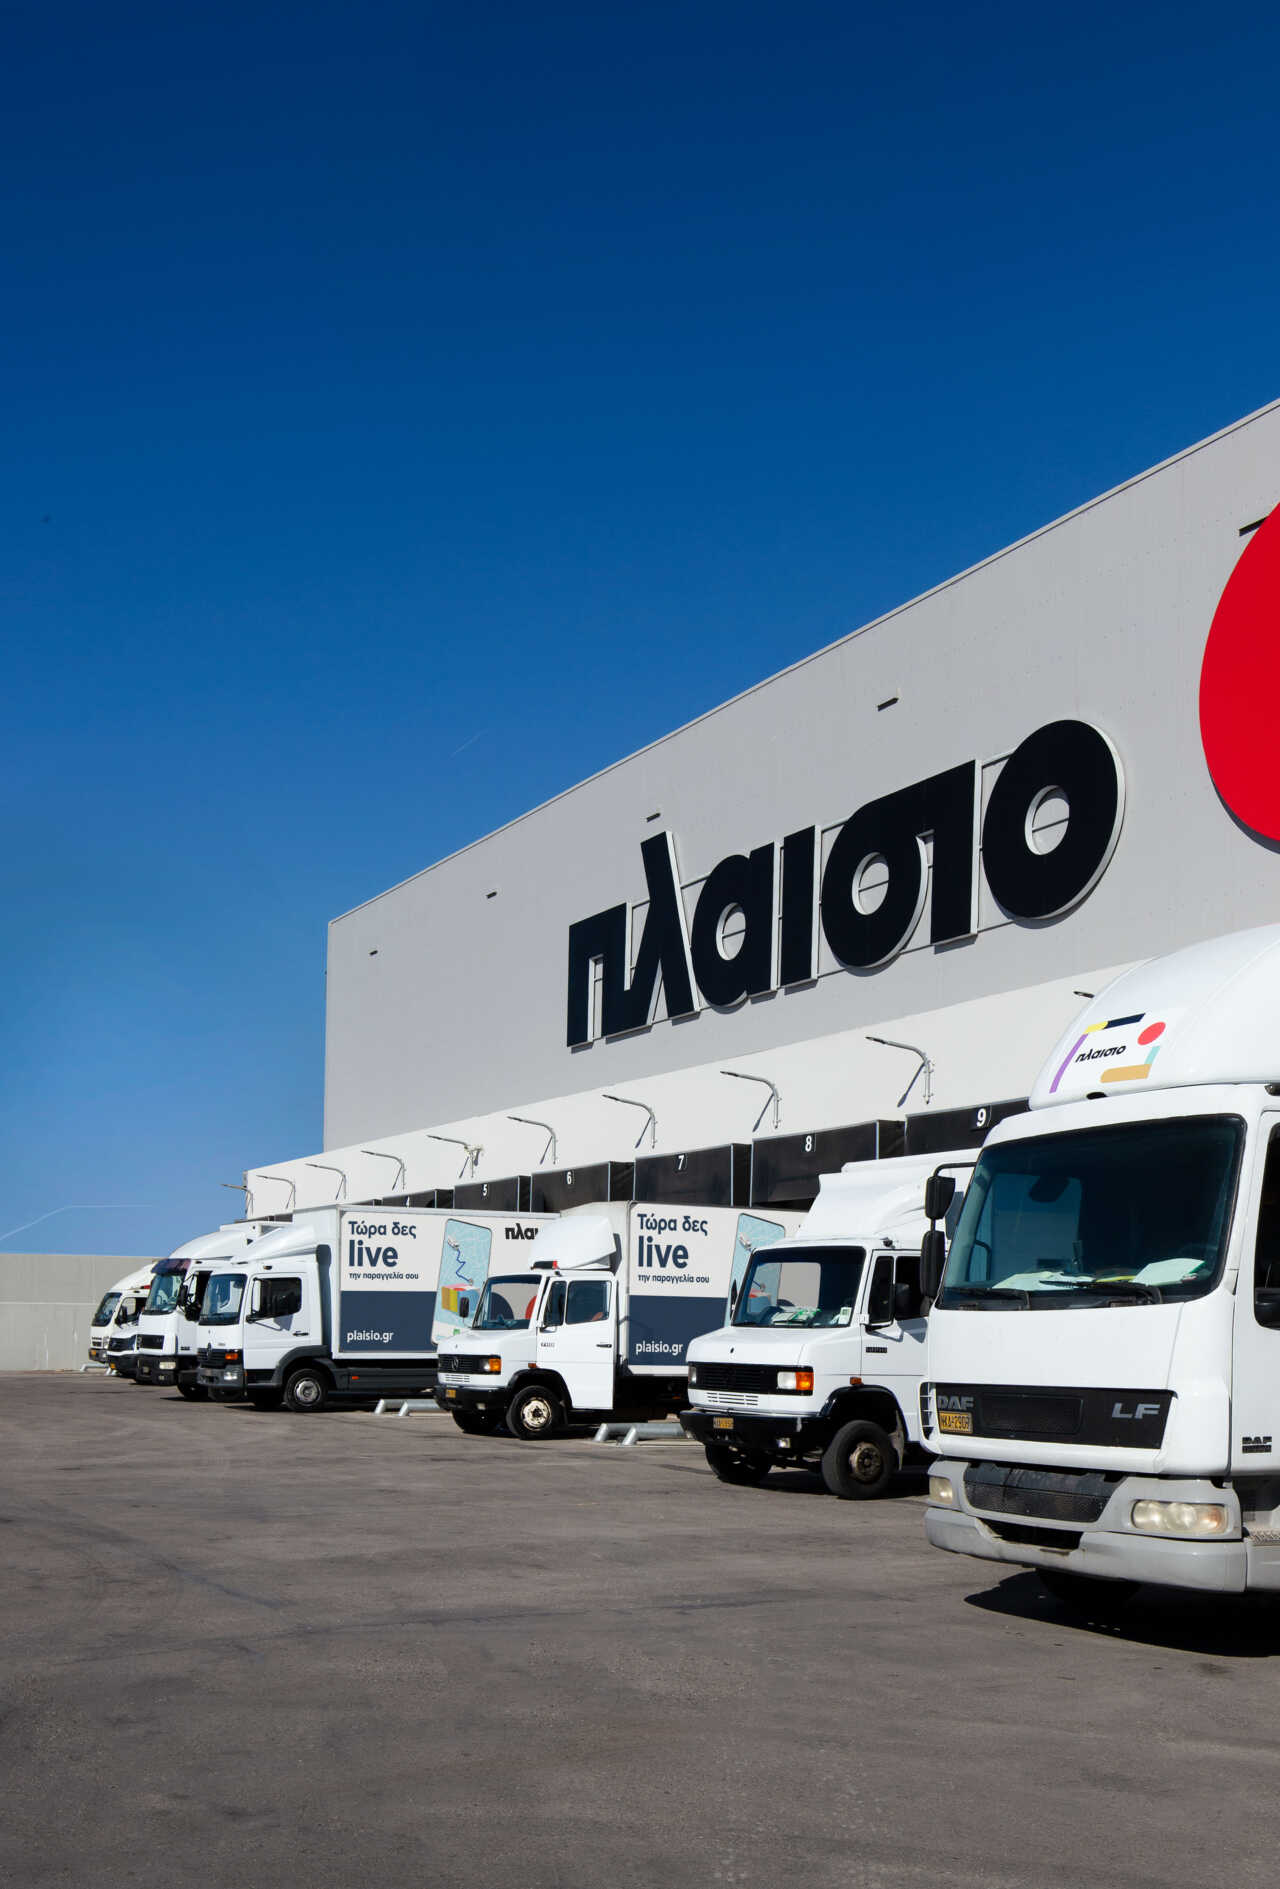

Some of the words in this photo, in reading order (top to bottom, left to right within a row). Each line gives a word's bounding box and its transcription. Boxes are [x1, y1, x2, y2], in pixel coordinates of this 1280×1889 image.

[976, 1108, 987, 1127] 9
[805, 1135, 813, 1153] 8
[677, 1154, 685, 1170] 7
[567, 1171, 573, 1185] 6
[482, 1184, 488, 1197] 5
[348, 1220, 387, 1239] Τώρα
[391, 1221, 417, 1239] δες
[637, 1213, 677, 1234] Τώρα
[682, 1215, 708, 1236] δες
[348, 1239, 399, 1268] live
[637, 1235, 689, 1269] live
[349, 1273, 361, 1281] την
[362, 1272, 404, 1281] παραγγελία
[638, 1274, 650, 1284] την
[652, 1274, 694, 1285] παραγγελία
[695, 1276, 710, 1284] σου
[346, 1329, 394, 1343] plaisio.gr
[635, 1340, 683, 1355] plaisio.gr
[937, 1395, 974, 1410] DAF
[1111, 1402, 1161, 1419] LF
